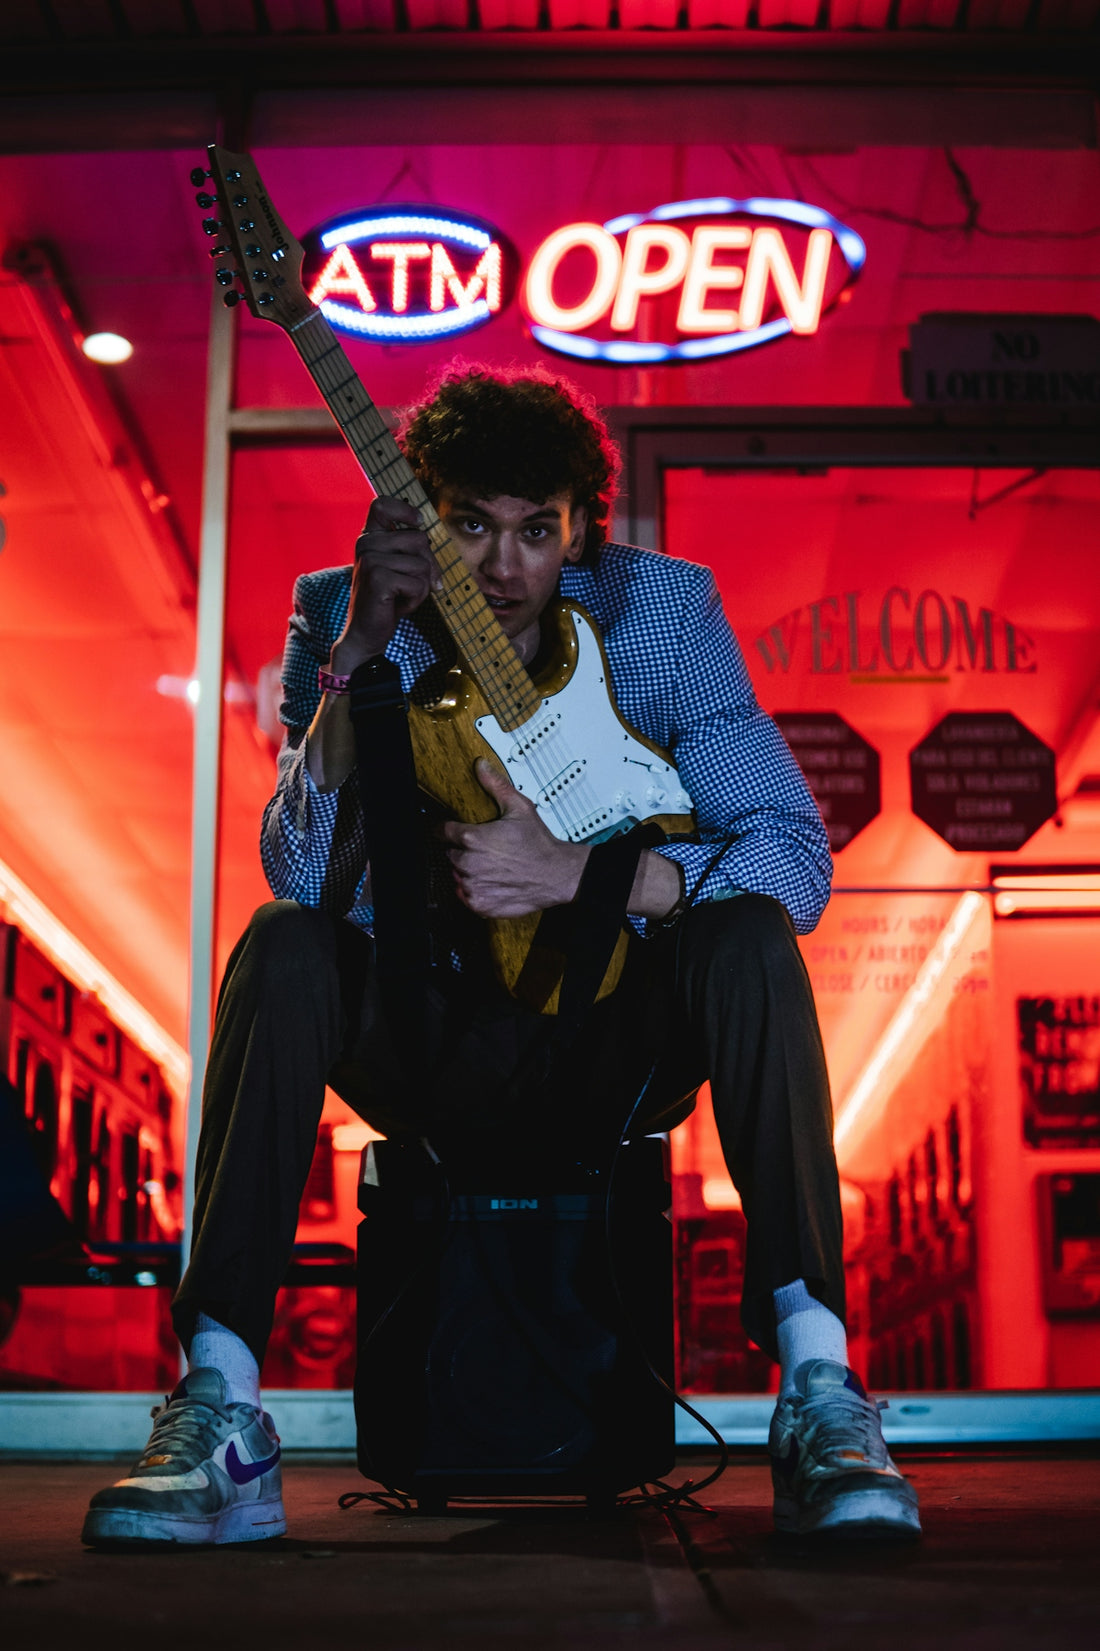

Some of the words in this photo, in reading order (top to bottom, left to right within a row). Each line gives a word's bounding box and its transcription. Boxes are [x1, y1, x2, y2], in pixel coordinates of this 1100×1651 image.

[258, 196, 290, 250] Johnson
[308, 243, 500, 312] ATM
[525, 222, 834, 335] OPEN
[991, 328, 1041, 363] NO
[754, 586, 1038, 674] WELCOME
[811, 944, 849, 962] OPEN
[490, 1199, 539, 1210] ION
